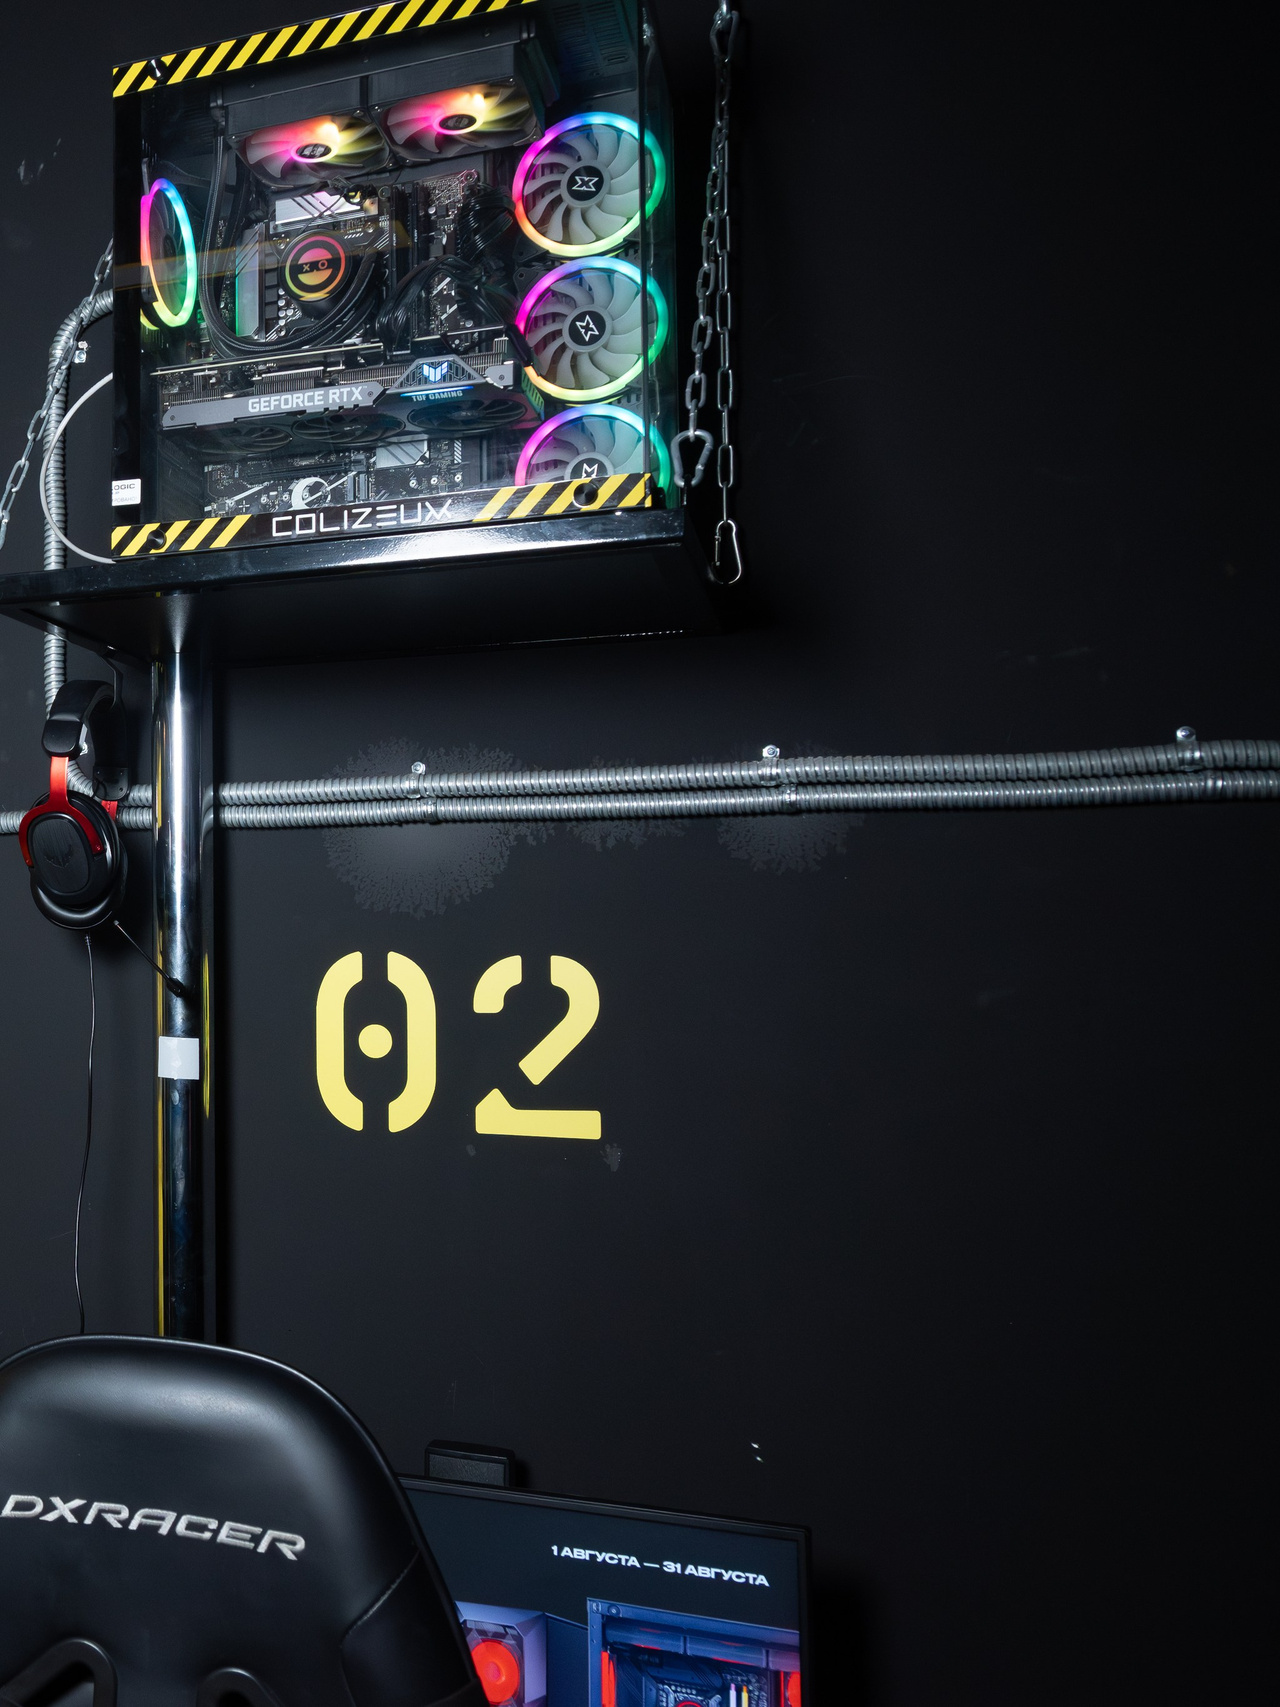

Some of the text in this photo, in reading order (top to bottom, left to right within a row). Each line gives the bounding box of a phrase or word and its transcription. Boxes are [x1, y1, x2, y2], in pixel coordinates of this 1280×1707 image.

[248, 391, 324, 412] GEFORCE
[429, 390, 463, 401] GAMING
[272, 499, 452, 537] COLIZEUM
[315, 951, 602, 1140] 02
[0, 1494, 305, 1561] DXRACER
[551, 1545, 558, 1556] 1
[560, 1546, 641, 1568] АВГУСТА
[662, 1561, 681, 1574] 31
[684, 1564, 770, 1587] АВГУСТА
